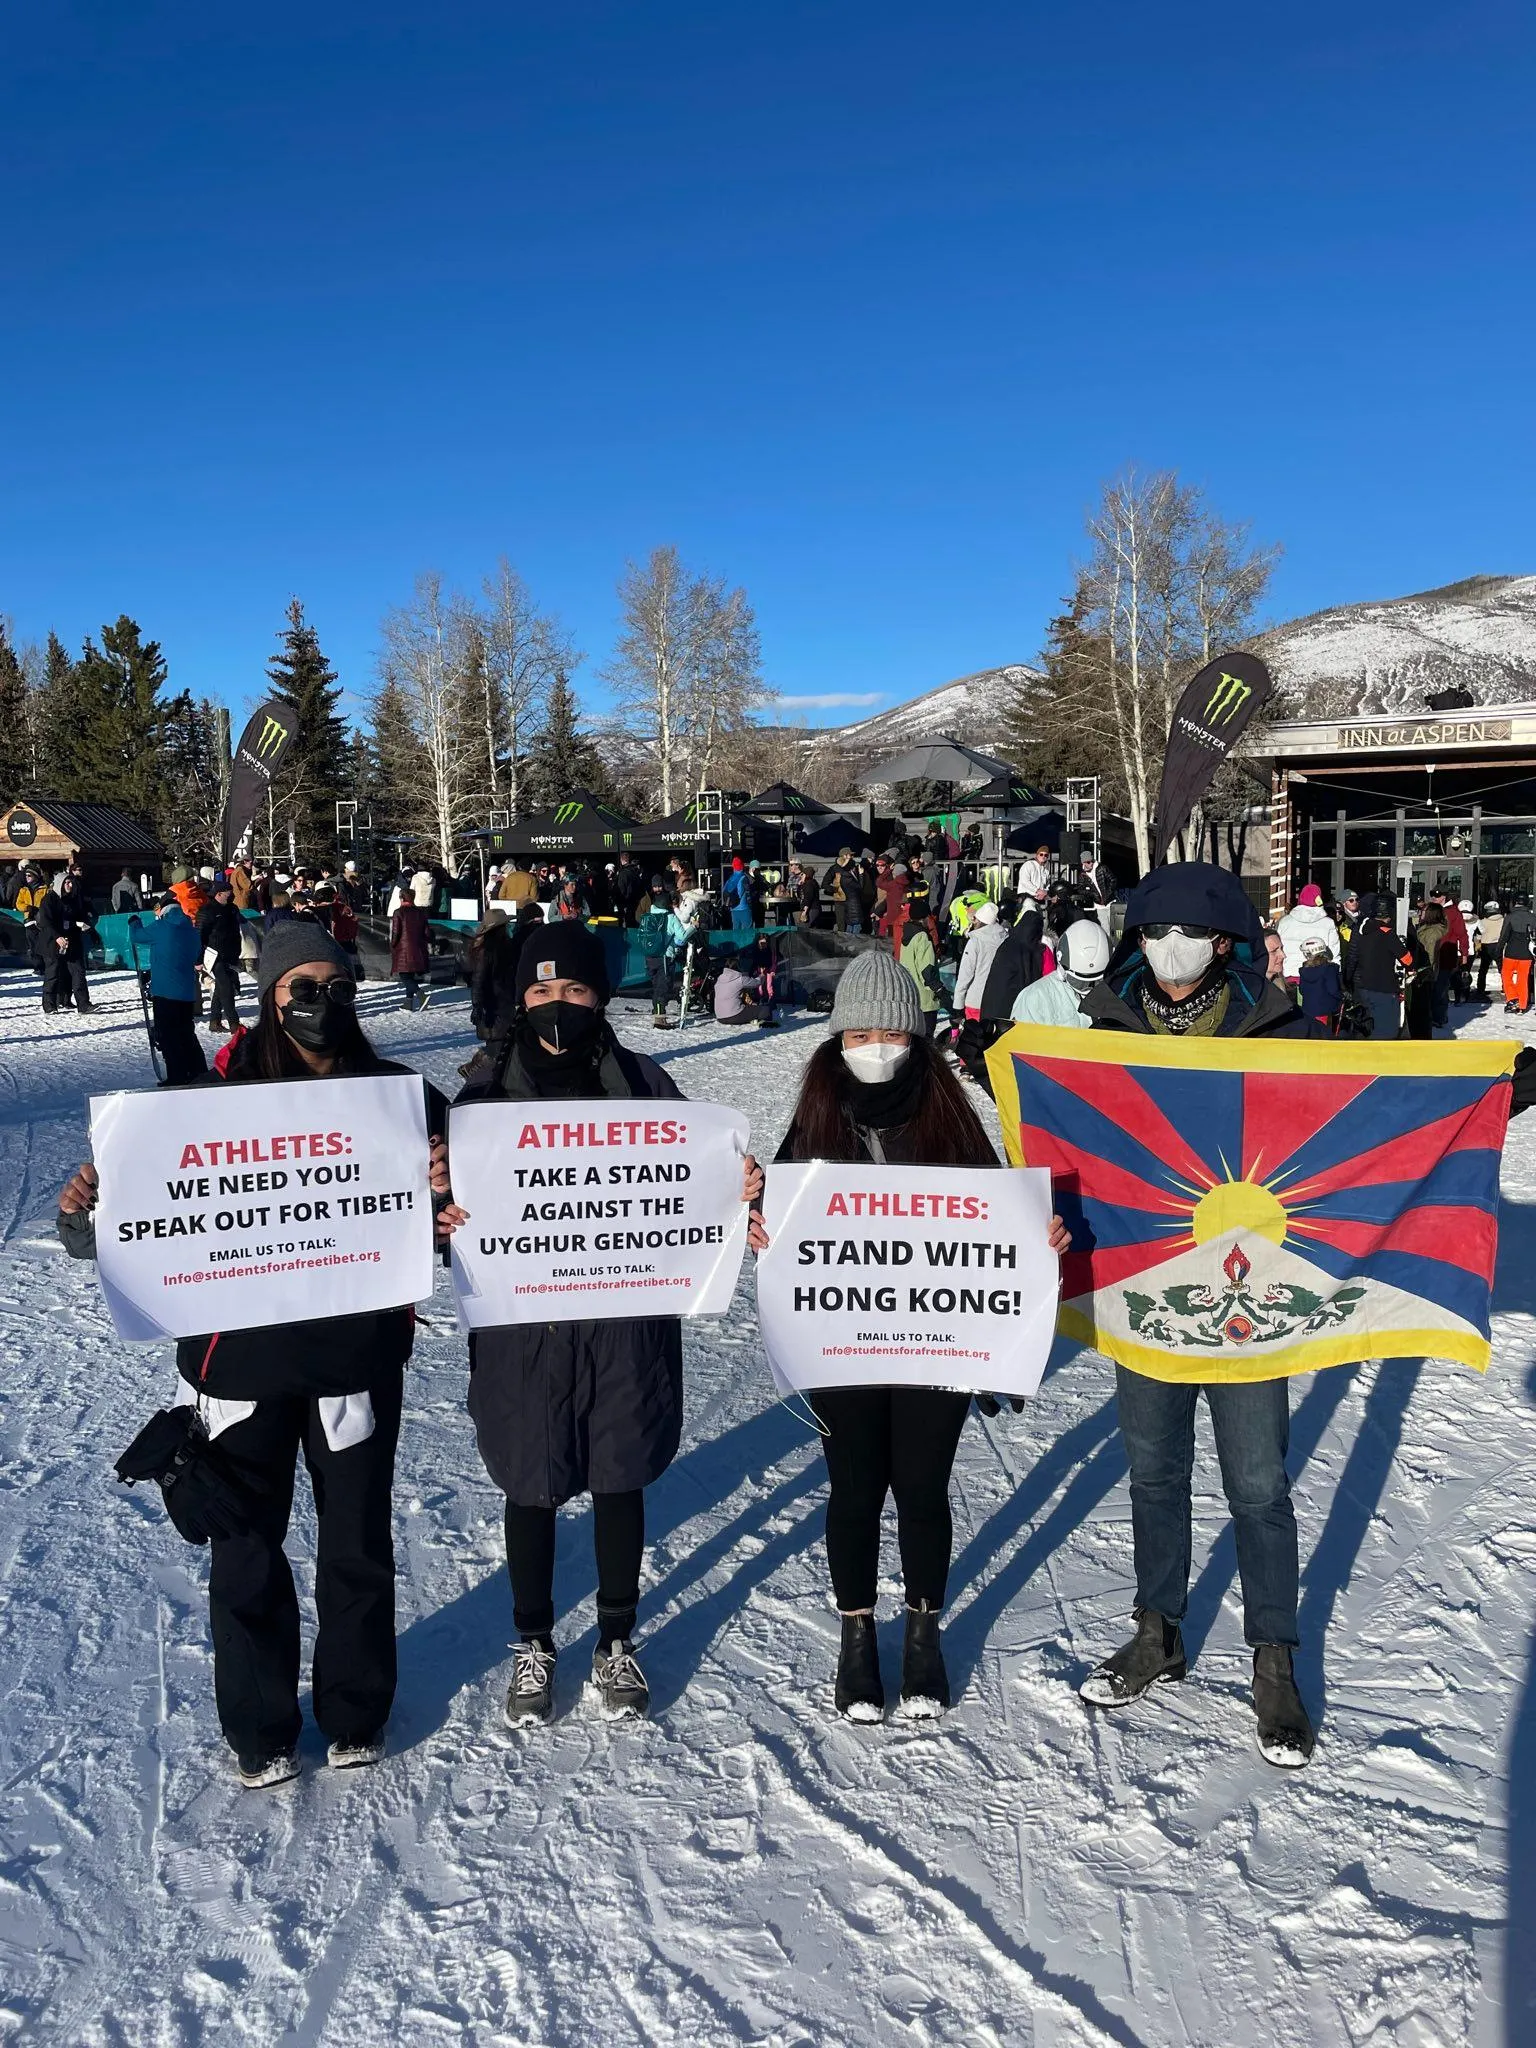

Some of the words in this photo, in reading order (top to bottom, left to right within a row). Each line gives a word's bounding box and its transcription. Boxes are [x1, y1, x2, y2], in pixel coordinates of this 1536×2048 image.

[1178, 716, 1226, 751] MONSTER
[1344, 728, 1383, 748] INN
[1387, 731, 1406, 743] at
[1411, 722, 1485, 744] ASPEN
[241, 748, 271, 779] MONSTER
[11, 821, 31, 831] Jeep
[661, 832, 707, 841] MONSTER
[530, 835, 574, 845] MONSTER
[517, 1121, 686, 1148] ATHLETES:
[180, 1132, 352, 1169] ATHLETES:
[167, 1178, 210, 1200] WE
[219, 1171, 288, 1195] NEED
[296, 1164, 360, 1186] YOU!
[514, 1168, 576, 1187] TAKE
[584, 1167, 601, 1185] A
[609, 1164, 690, 1184] STAND
[119, 1214, 207, 1242] SPEAK
[215, 1207, 270, 1231] OUT
[280, 1201, 331, 1224] FOR
[337, 1191, 413, 1217] TIBET!
[521, 1200, 632, 1221] AGAINST
[640, 1197, 684, 1216] THE
[827, 1193, 988, 1219] ATHLETES:
[210, 1249, 252, 1262] EMAIL
[256, 1245, 273, 1256] US
[277, 1243, 294, 1253] TO
[298, 1238, 335, 1250] TALK:
[480, 1235, 587, 1255] UYGHUR
[595, 1225, 723, 1250] GENOCIDE!
[798, 1240, 913, 1265] STAND
[924, 1241, 1016, 1268] WITH
[164, 1250, 380, 1285] Info@studentsforafreetibet.org
[553, 1268, 586, 1277] EMAIL
[590, 1267, 603, 1275] US
[607, 1266, 621, 1274] TO
[625, 1265, 654, 1273] TALK:
[516, 1278, 691, 1294] Info@studentsforafreetibet.org
[795, 1287, 896, 1312] HONG
[910, 1288, 1021, 1315] KONG!
[926, 1334, 954, 1342] TALK:
[823, 1346, 989, 1361] Info@studentsforafreetibet.org
